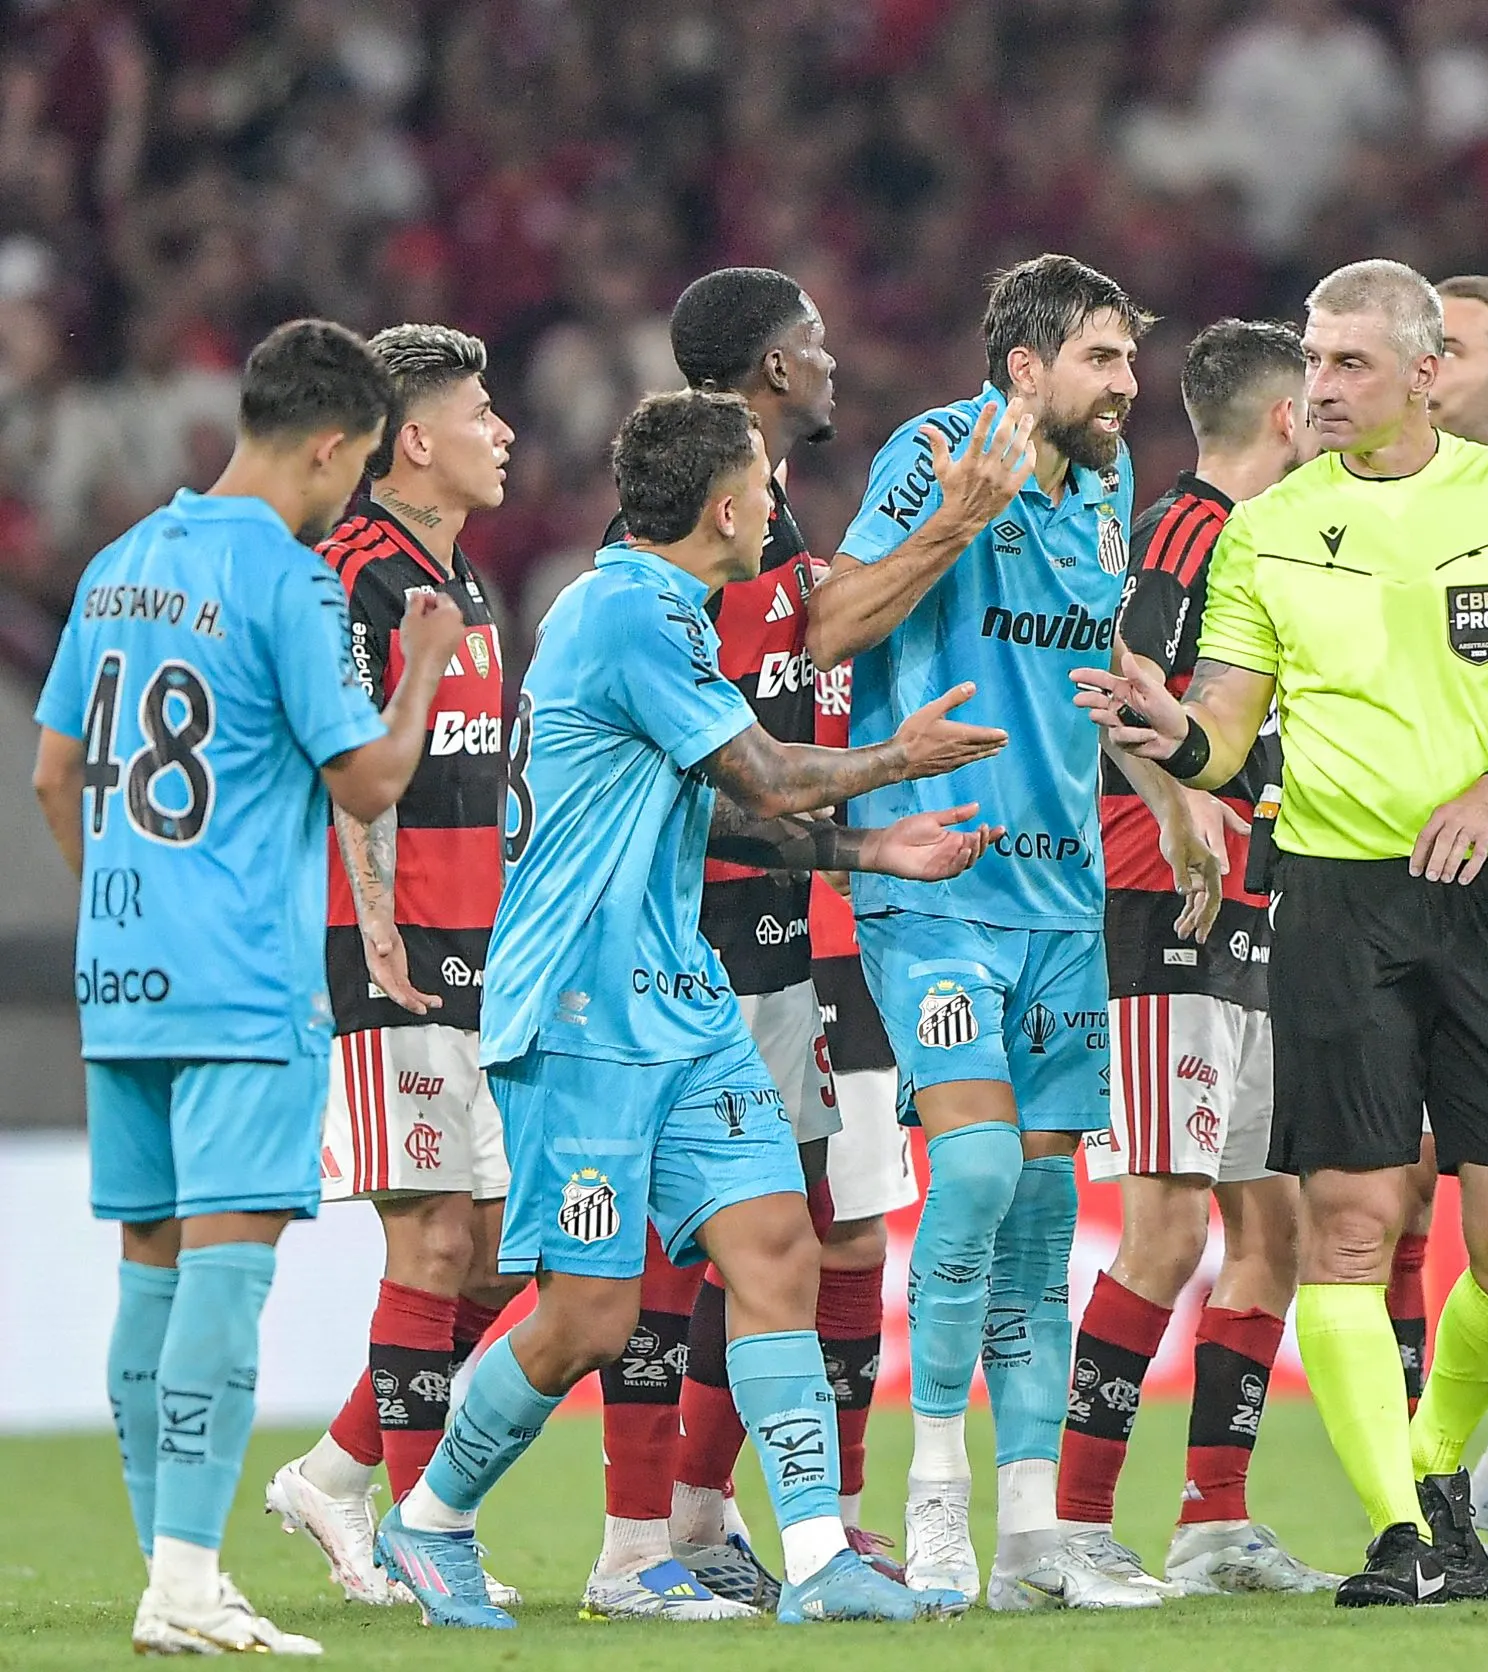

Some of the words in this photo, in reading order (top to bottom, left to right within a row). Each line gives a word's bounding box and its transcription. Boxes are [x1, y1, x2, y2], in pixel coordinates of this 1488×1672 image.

[994, 543, 1022, 556] umbro
[84, 585, 186, 625] GUSTAVO
[194, 601, 224, 638] H.
[82, 649, 217, 847] 48
[1086, 1032, 1110, 1050] CU
[1176, 1054, 1219, 1090] Wap
[397, 1069, 445, 1100] Wap
[622, 1357, 668, 1380] Zé
[624, 1379, 668, 1388] DELIVERY
[376, 1397, 409, 1419] Zé
[782, 1479, 800, 1488] BY
[801, 1473, 825, 1483] NEY
